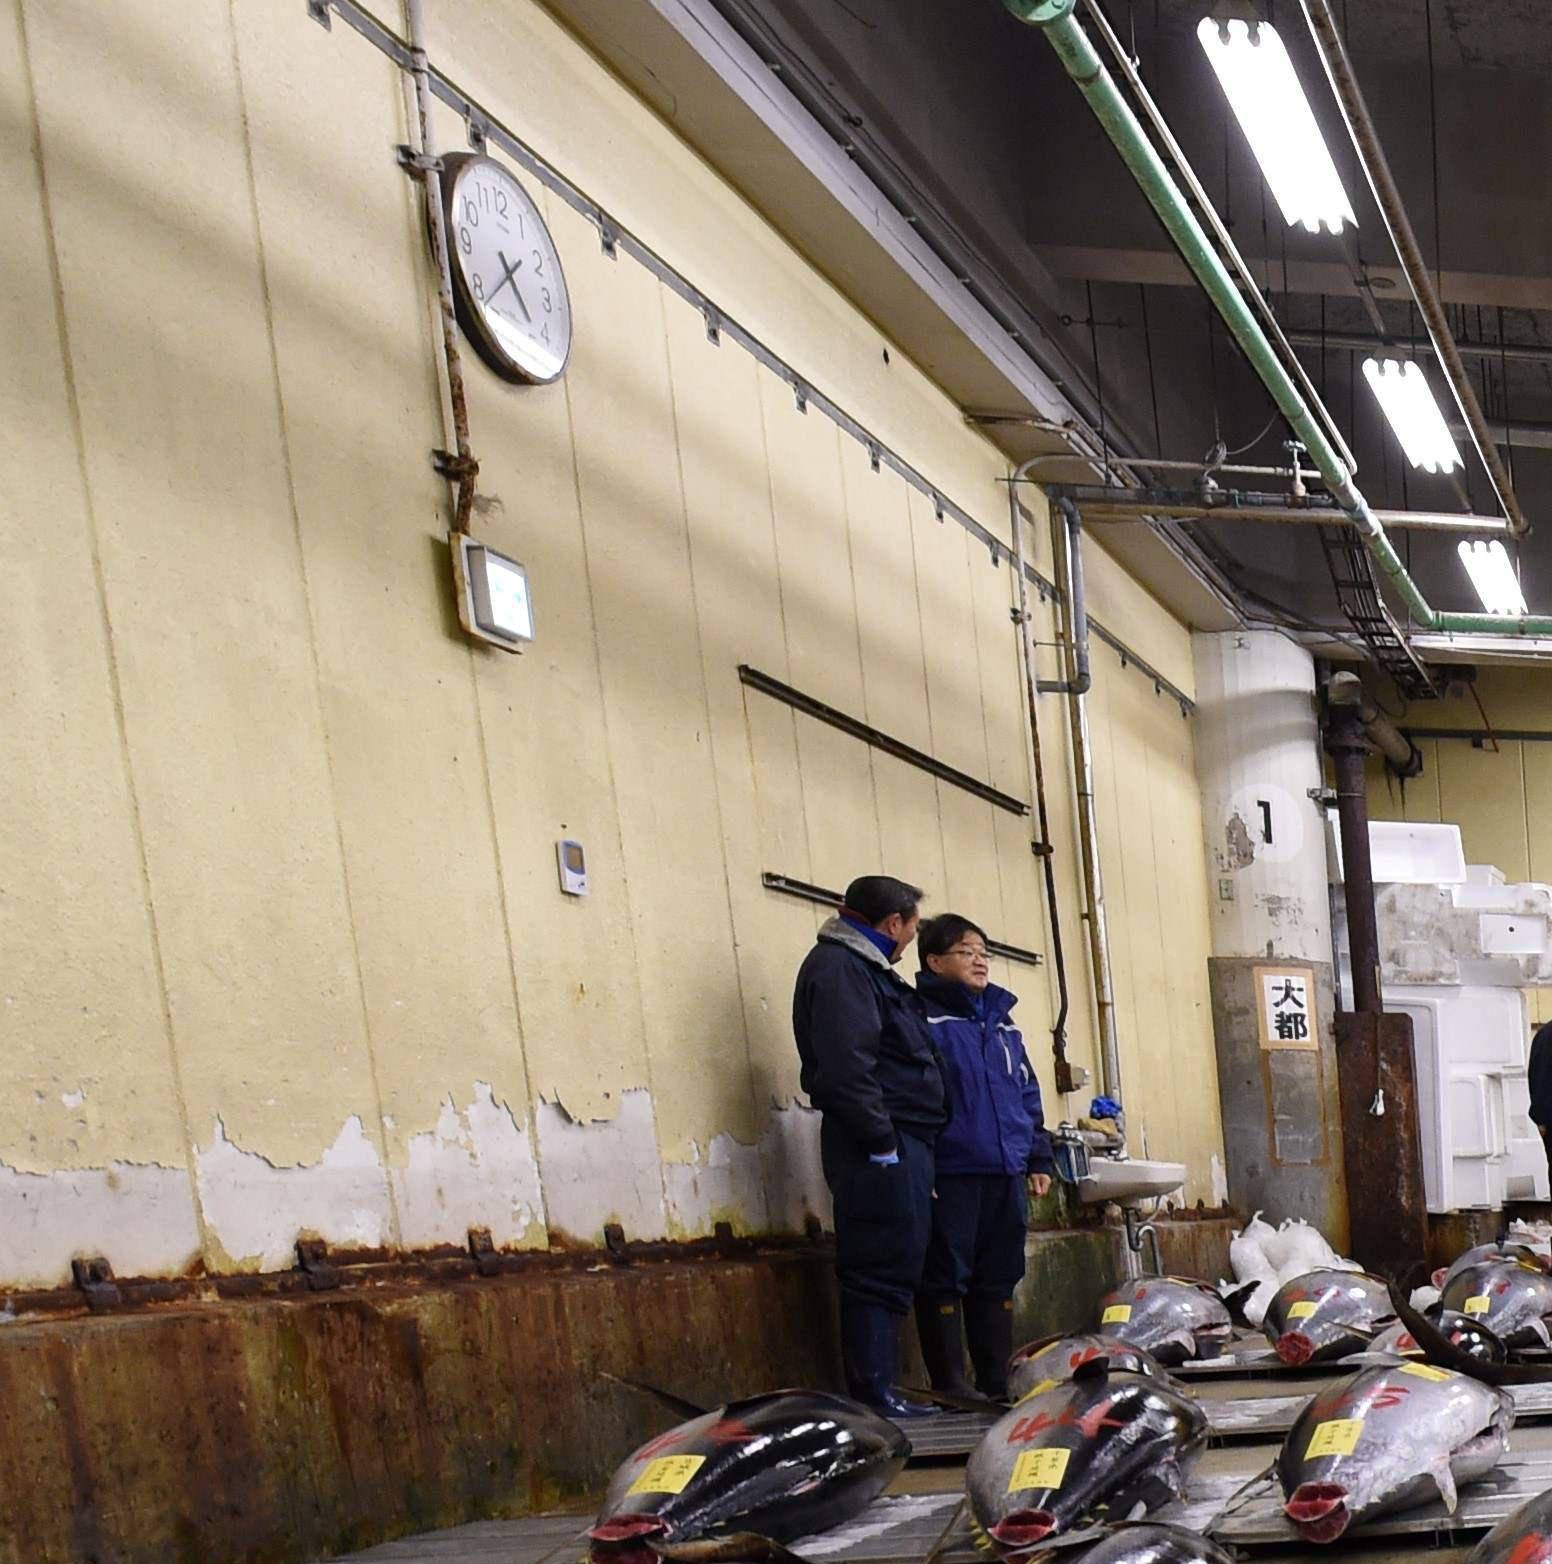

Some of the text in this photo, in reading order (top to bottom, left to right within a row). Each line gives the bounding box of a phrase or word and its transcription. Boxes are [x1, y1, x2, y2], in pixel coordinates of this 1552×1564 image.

[462, 195, 479, 227] 10
[492, 186, 509, 220] 12
[460, 226, 473, 255] 9
[532, 249, 544, 277] 2
[472, 273, 485, 300] 8
[541, 287, 553, 313] 3
[1256, 800, 1273, 844] 1
[1271, 978, 1308, 1041] 大都
